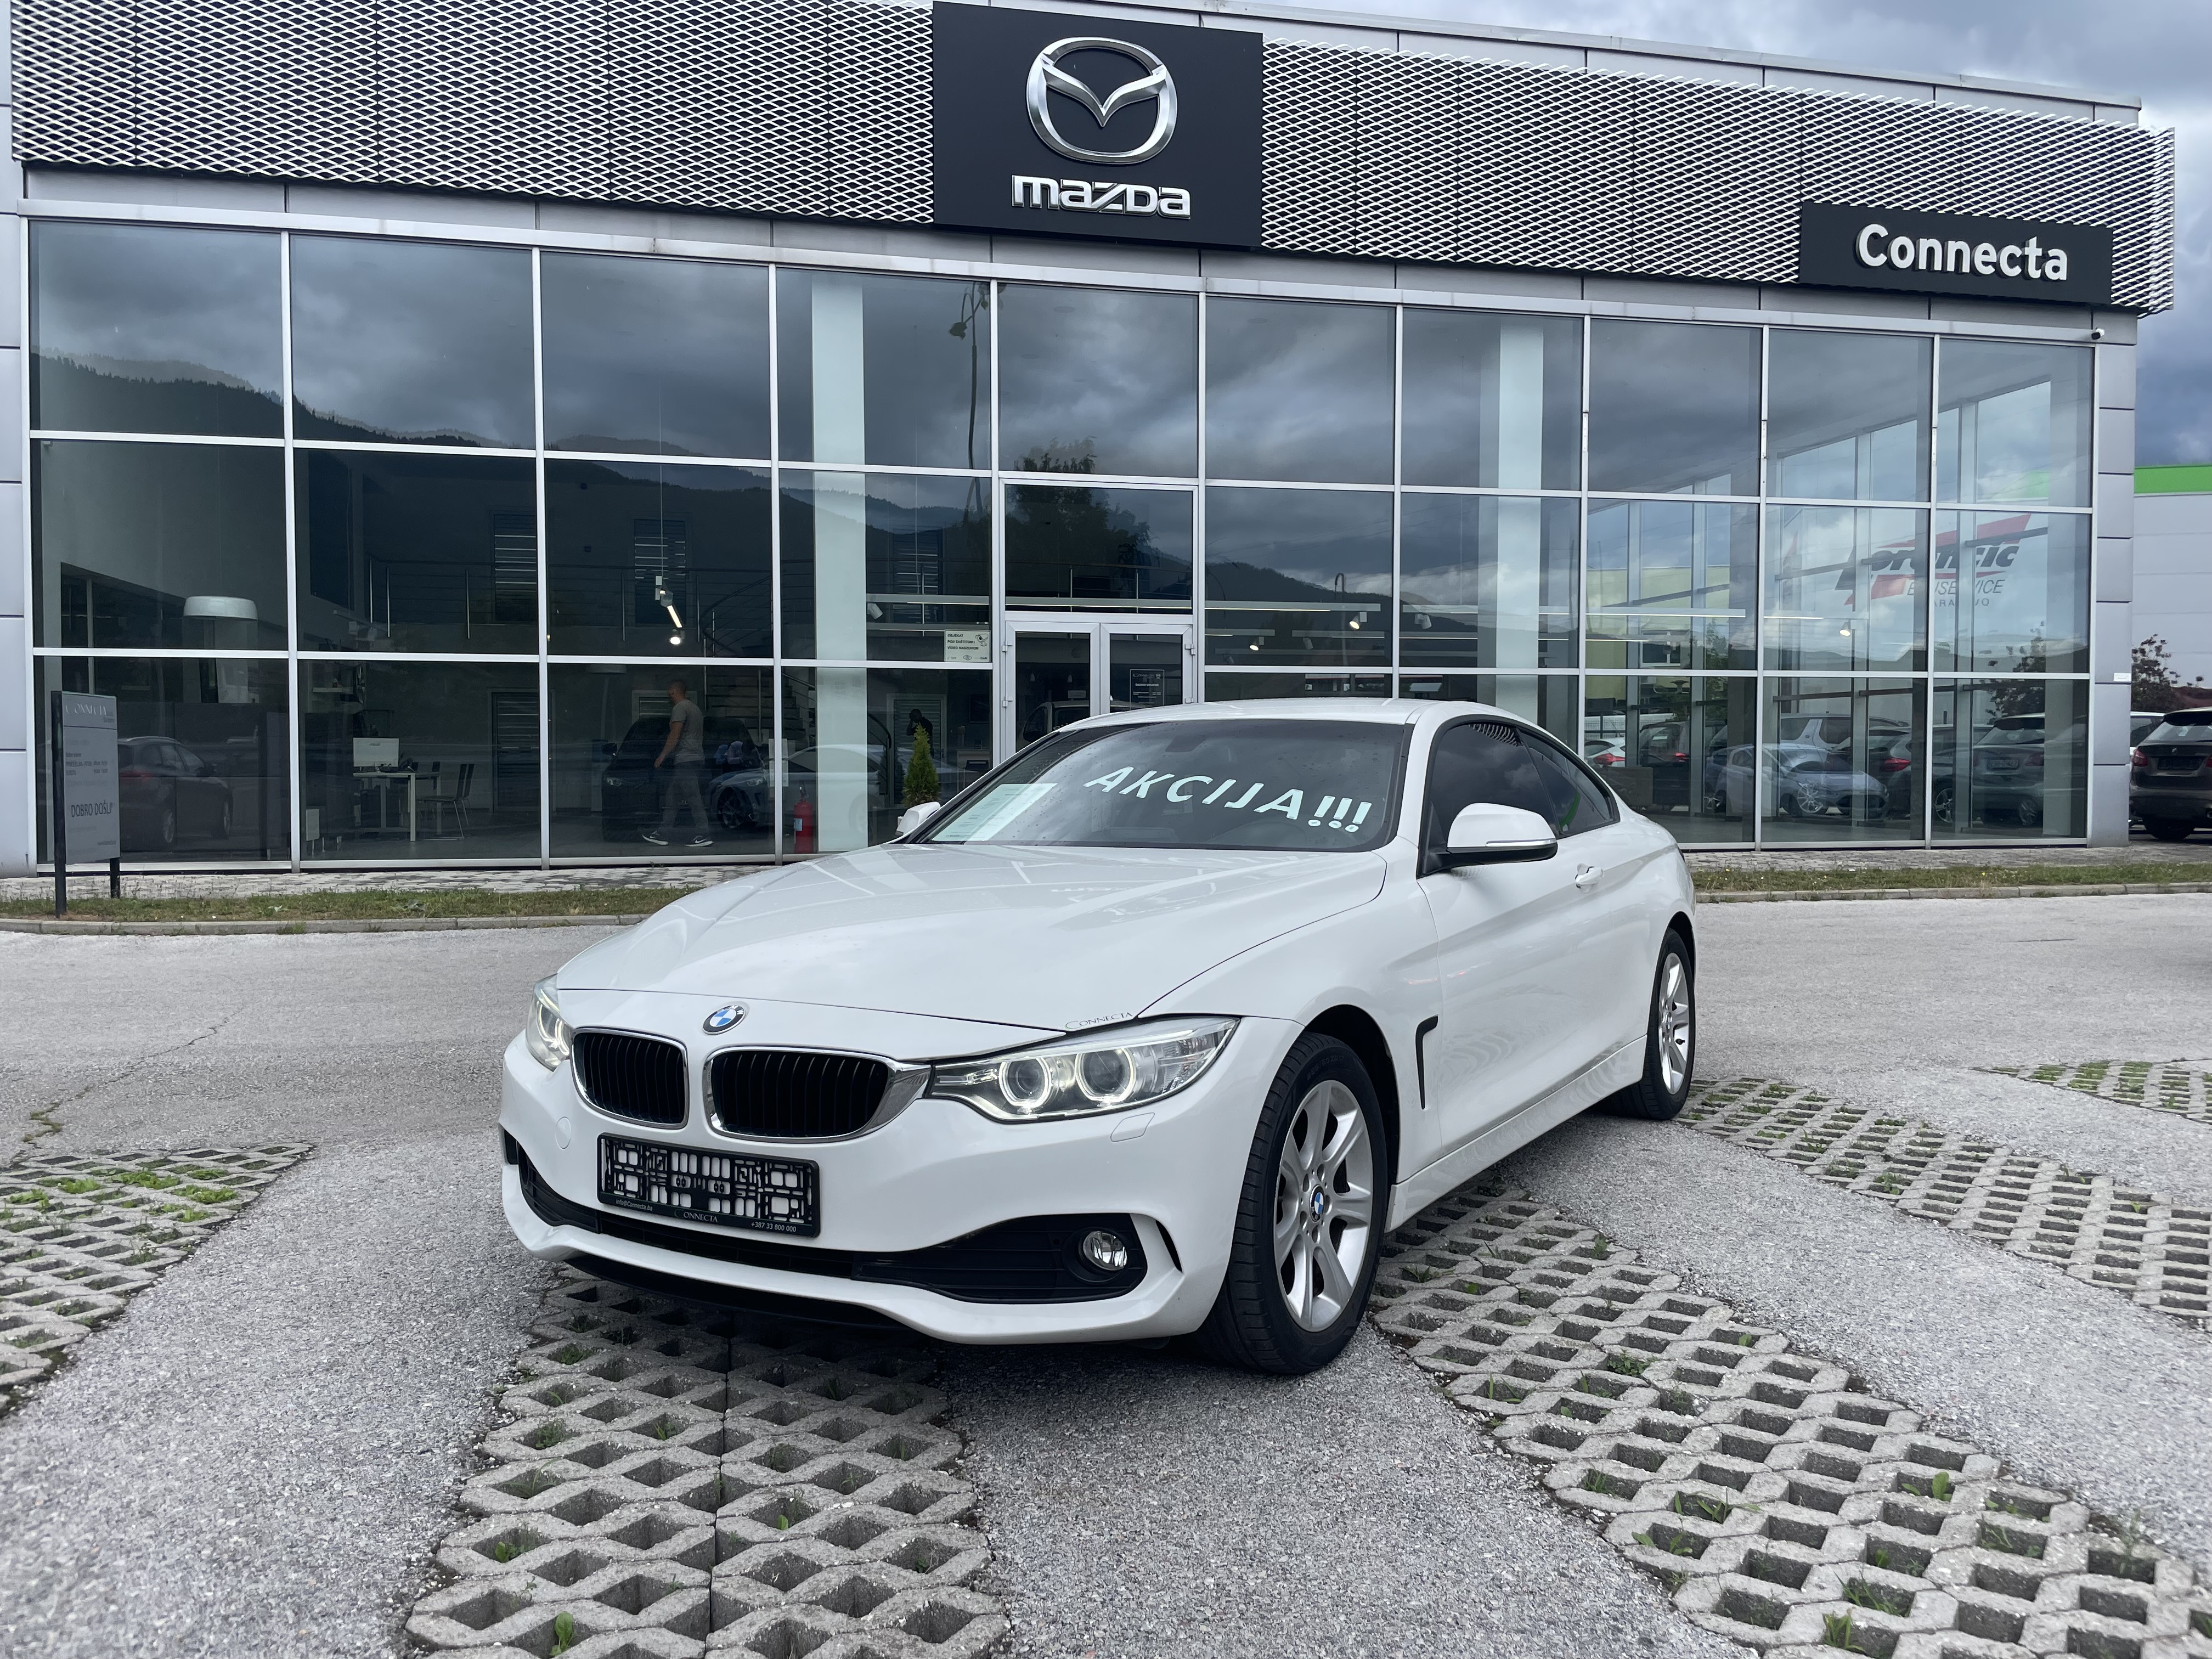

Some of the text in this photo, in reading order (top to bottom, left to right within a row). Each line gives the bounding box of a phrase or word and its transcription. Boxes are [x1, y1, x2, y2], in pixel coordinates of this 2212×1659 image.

[1855, 224, 2068, 281] Connecta
[1082, 766, 1372, 833] AKCIJA!!!
[70, 803, 93, 817] DOBRO
[1064, 1012, 1133, 1030] CONNECTA
[615, 1199, 653, 1211] info@Connecta.ba
[674, 1209, 718, 1223] CONNECTA
